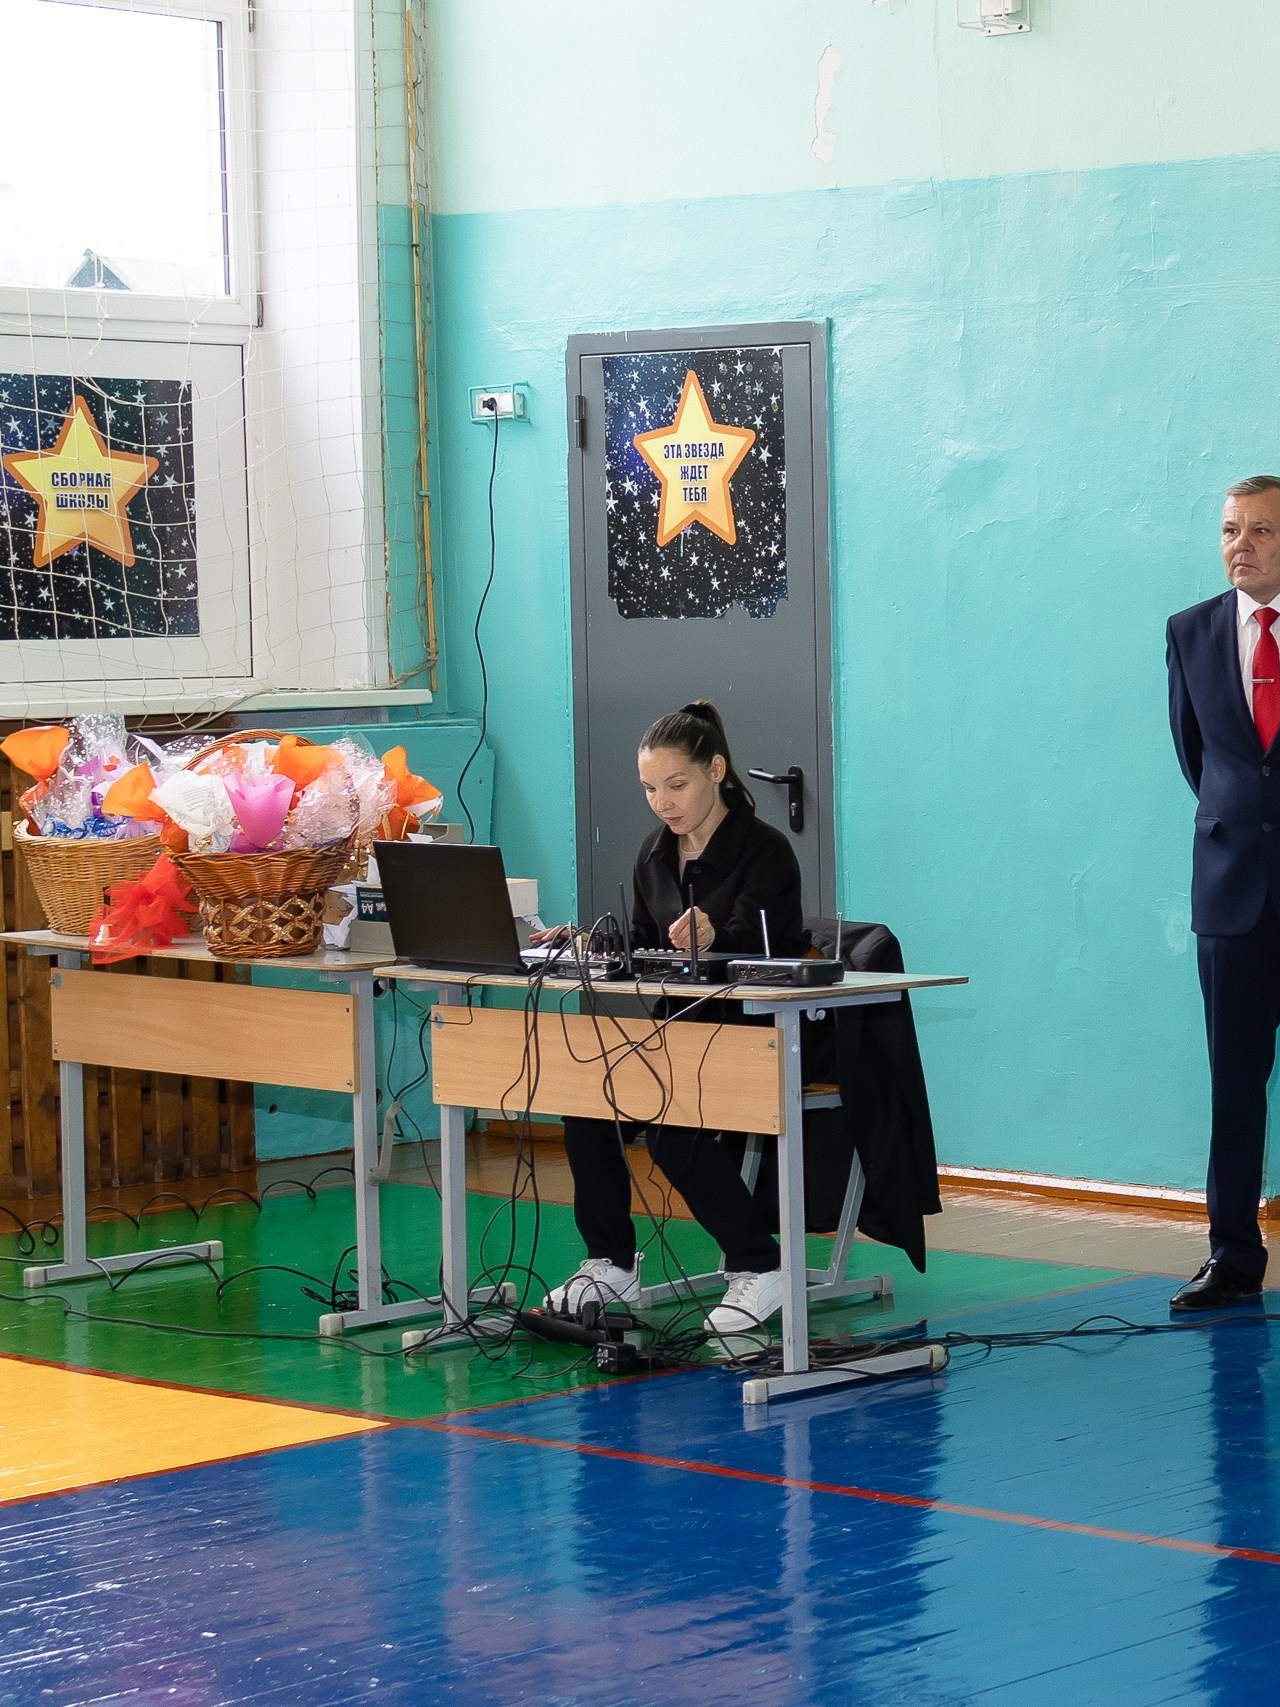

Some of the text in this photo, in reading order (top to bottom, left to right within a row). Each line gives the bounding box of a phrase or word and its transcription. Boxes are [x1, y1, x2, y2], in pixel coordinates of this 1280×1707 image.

[664, 442, 725, 460] ЭТА ЗВЕЗДА
[51, 472, 112, 488] СБОРНАЯ
[680, 464, 708, 482] ЖДЕТ
[56, 493, 109, 510] ШКОЛЫ
[682, 485, 708, 503] ТЕБЯ
